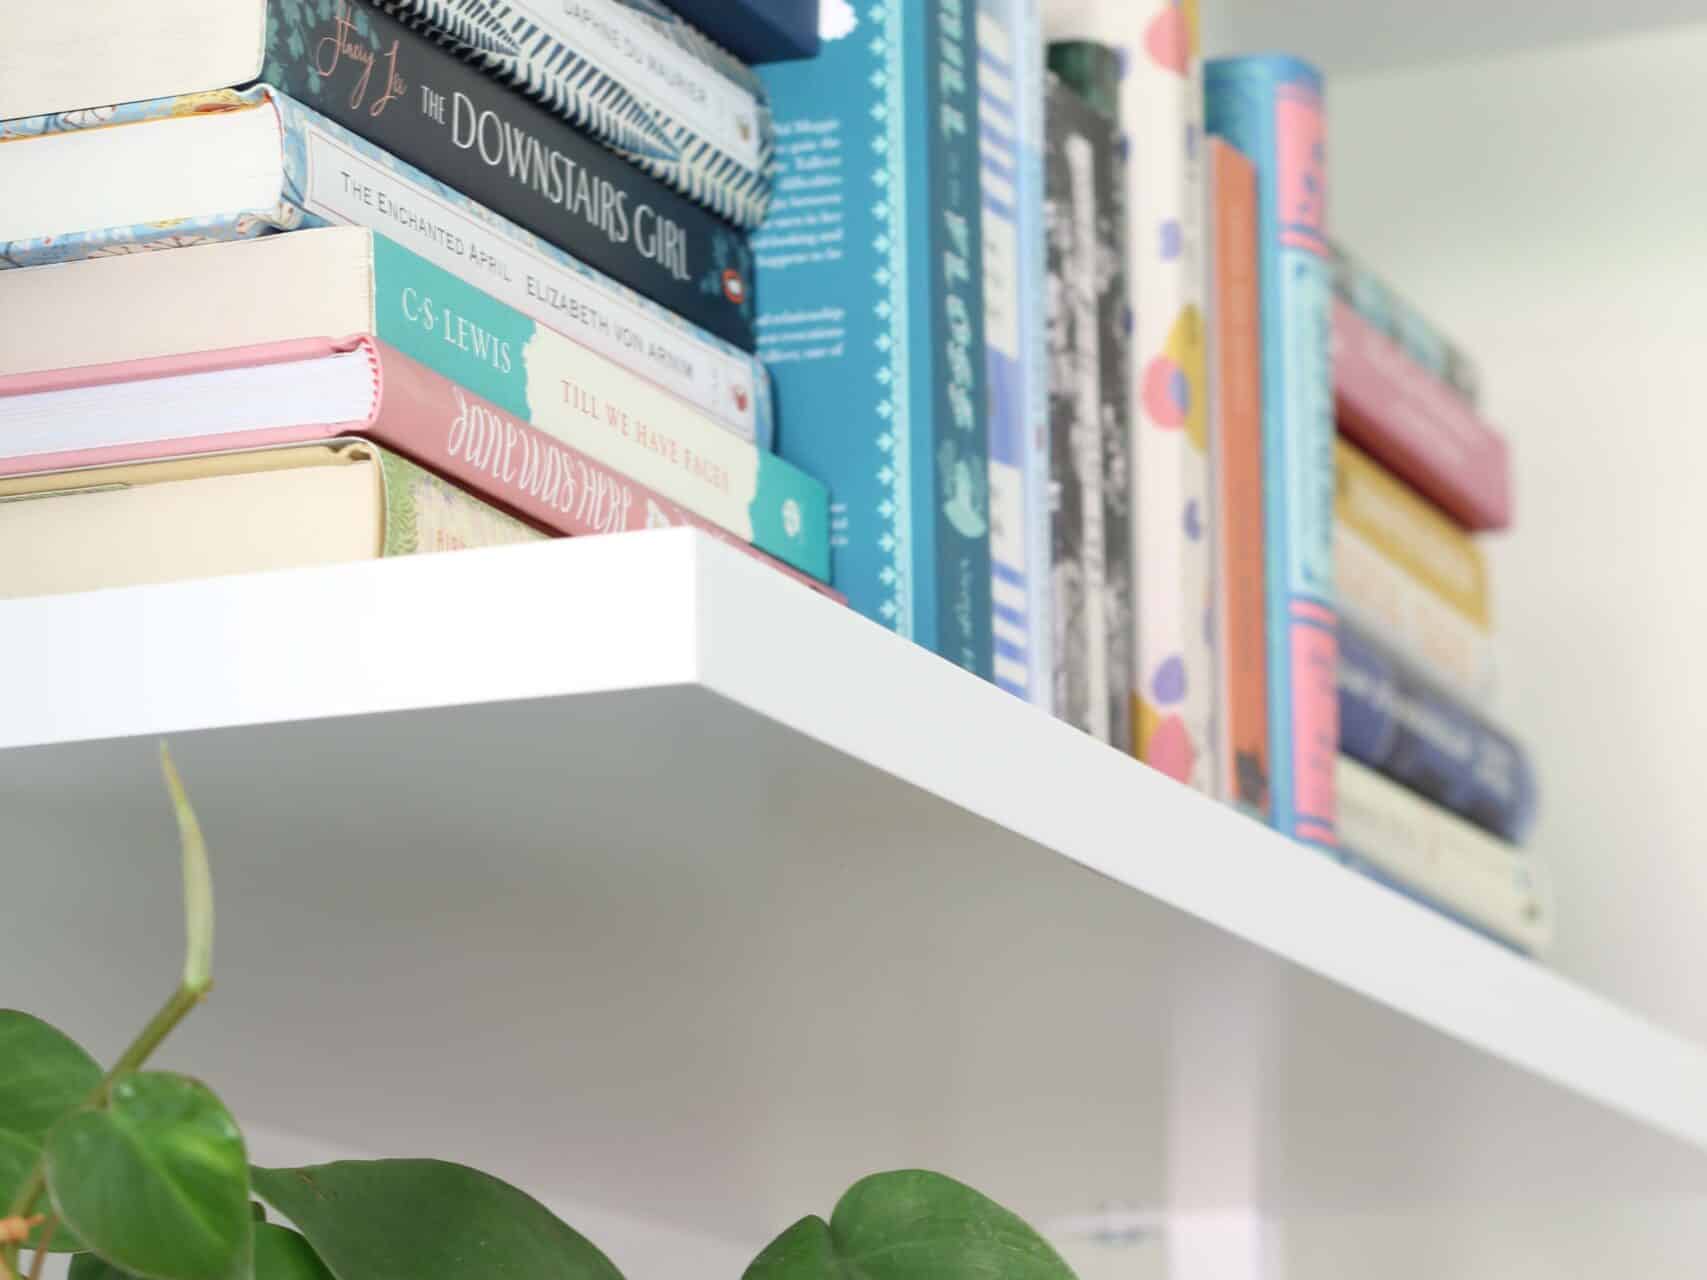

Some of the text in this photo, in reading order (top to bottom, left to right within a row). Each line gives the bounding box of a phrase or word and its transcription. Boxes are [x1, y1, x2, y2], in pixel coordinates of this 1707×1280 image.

[369, 40, 408, 117] Lee
[420, 85, 692, 281] THE DOWNSTAIRS GIRL
[340, 169, 513, 283] THE ENCHANTED APRIL
[443, 308, 512, 374] LEWIS
[526, 275, 610, 335] ELIZABETH
[615, 322, 644, 353] VON
[560, 378, 601, 421] TILL
[605, 401, 631, 439] WE
[635, 419, 680, 465] HAVE
